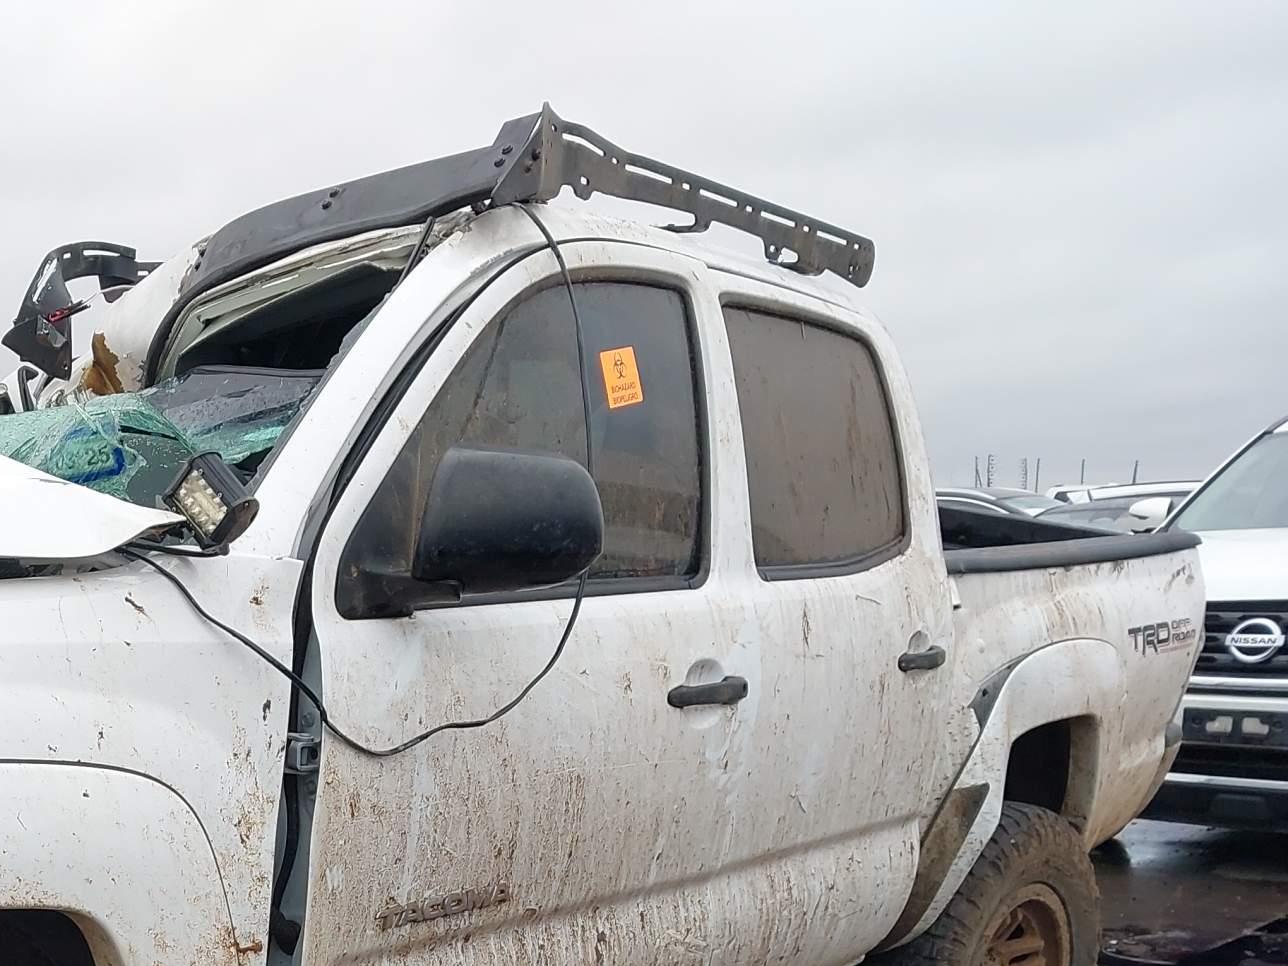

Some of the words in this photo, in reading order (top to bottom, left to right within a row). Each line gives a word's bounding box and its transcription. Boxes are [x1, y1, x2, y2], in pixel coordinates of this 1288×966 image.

[87, 444, 111, 466] 25
[1127, 621, 1170, 657] TRD
[1171, 617, 1193, 630] OFF
[1171, 628, 1197, 643] ROAD
[1229, 636, 1278, 645] NISSAN
[374, 880, 521, 932] TACOMA
